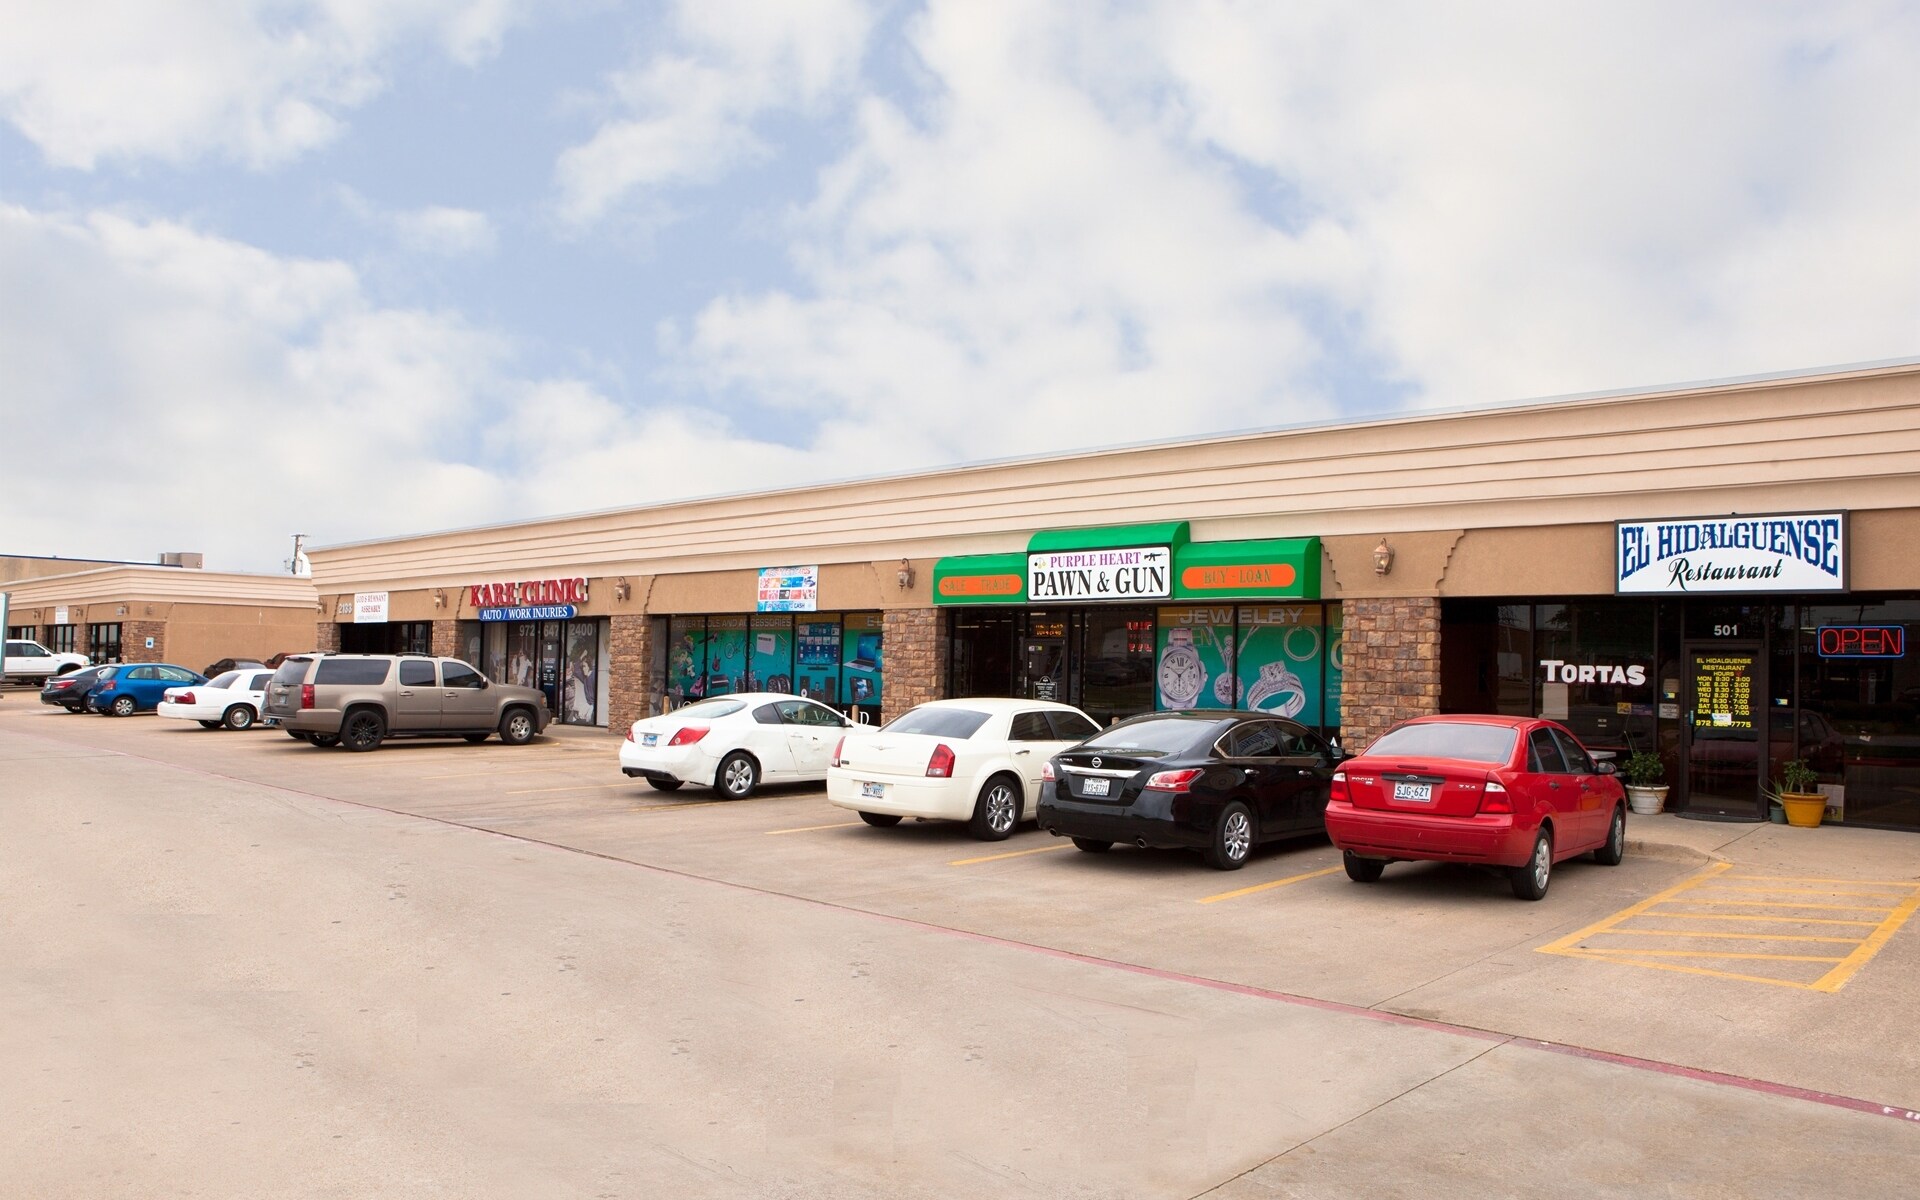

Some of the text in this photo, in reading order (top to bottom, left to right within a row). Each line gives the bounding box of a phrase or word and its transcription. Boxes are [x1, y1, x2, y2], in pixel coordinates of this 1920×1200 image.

[1621, 519, 1839, 581] EL HIDALGUENSE
[1050, 551, 1142, 568] PURPLE HEART
[1033, 566, 1165, 597] PAWN & GUN
[1204, 568, 1229, 584] BUY
[1239, 568, 1272, 583] LOAN
[1666, 557, 1783, 592] Restaurant
[470, 577, 587, 607] KARE CLINIC
[943, 580, 967, 592] SALE
[980, 578, 1011, 592] TRADE
[482, 606, 568, 620] AUTO / WORK INJURIES
[1179, 607, 1304, 624] JEWELRY
[519, 624, 536, 637] 972
[543, 624, 559, 638] 647
[569, 623, 593, 636] 2400
[1714, 624, 1738, 636] 501
[1820, 628, 1902, 655] OPEN
[1695, 719, 1712, 727] 972
